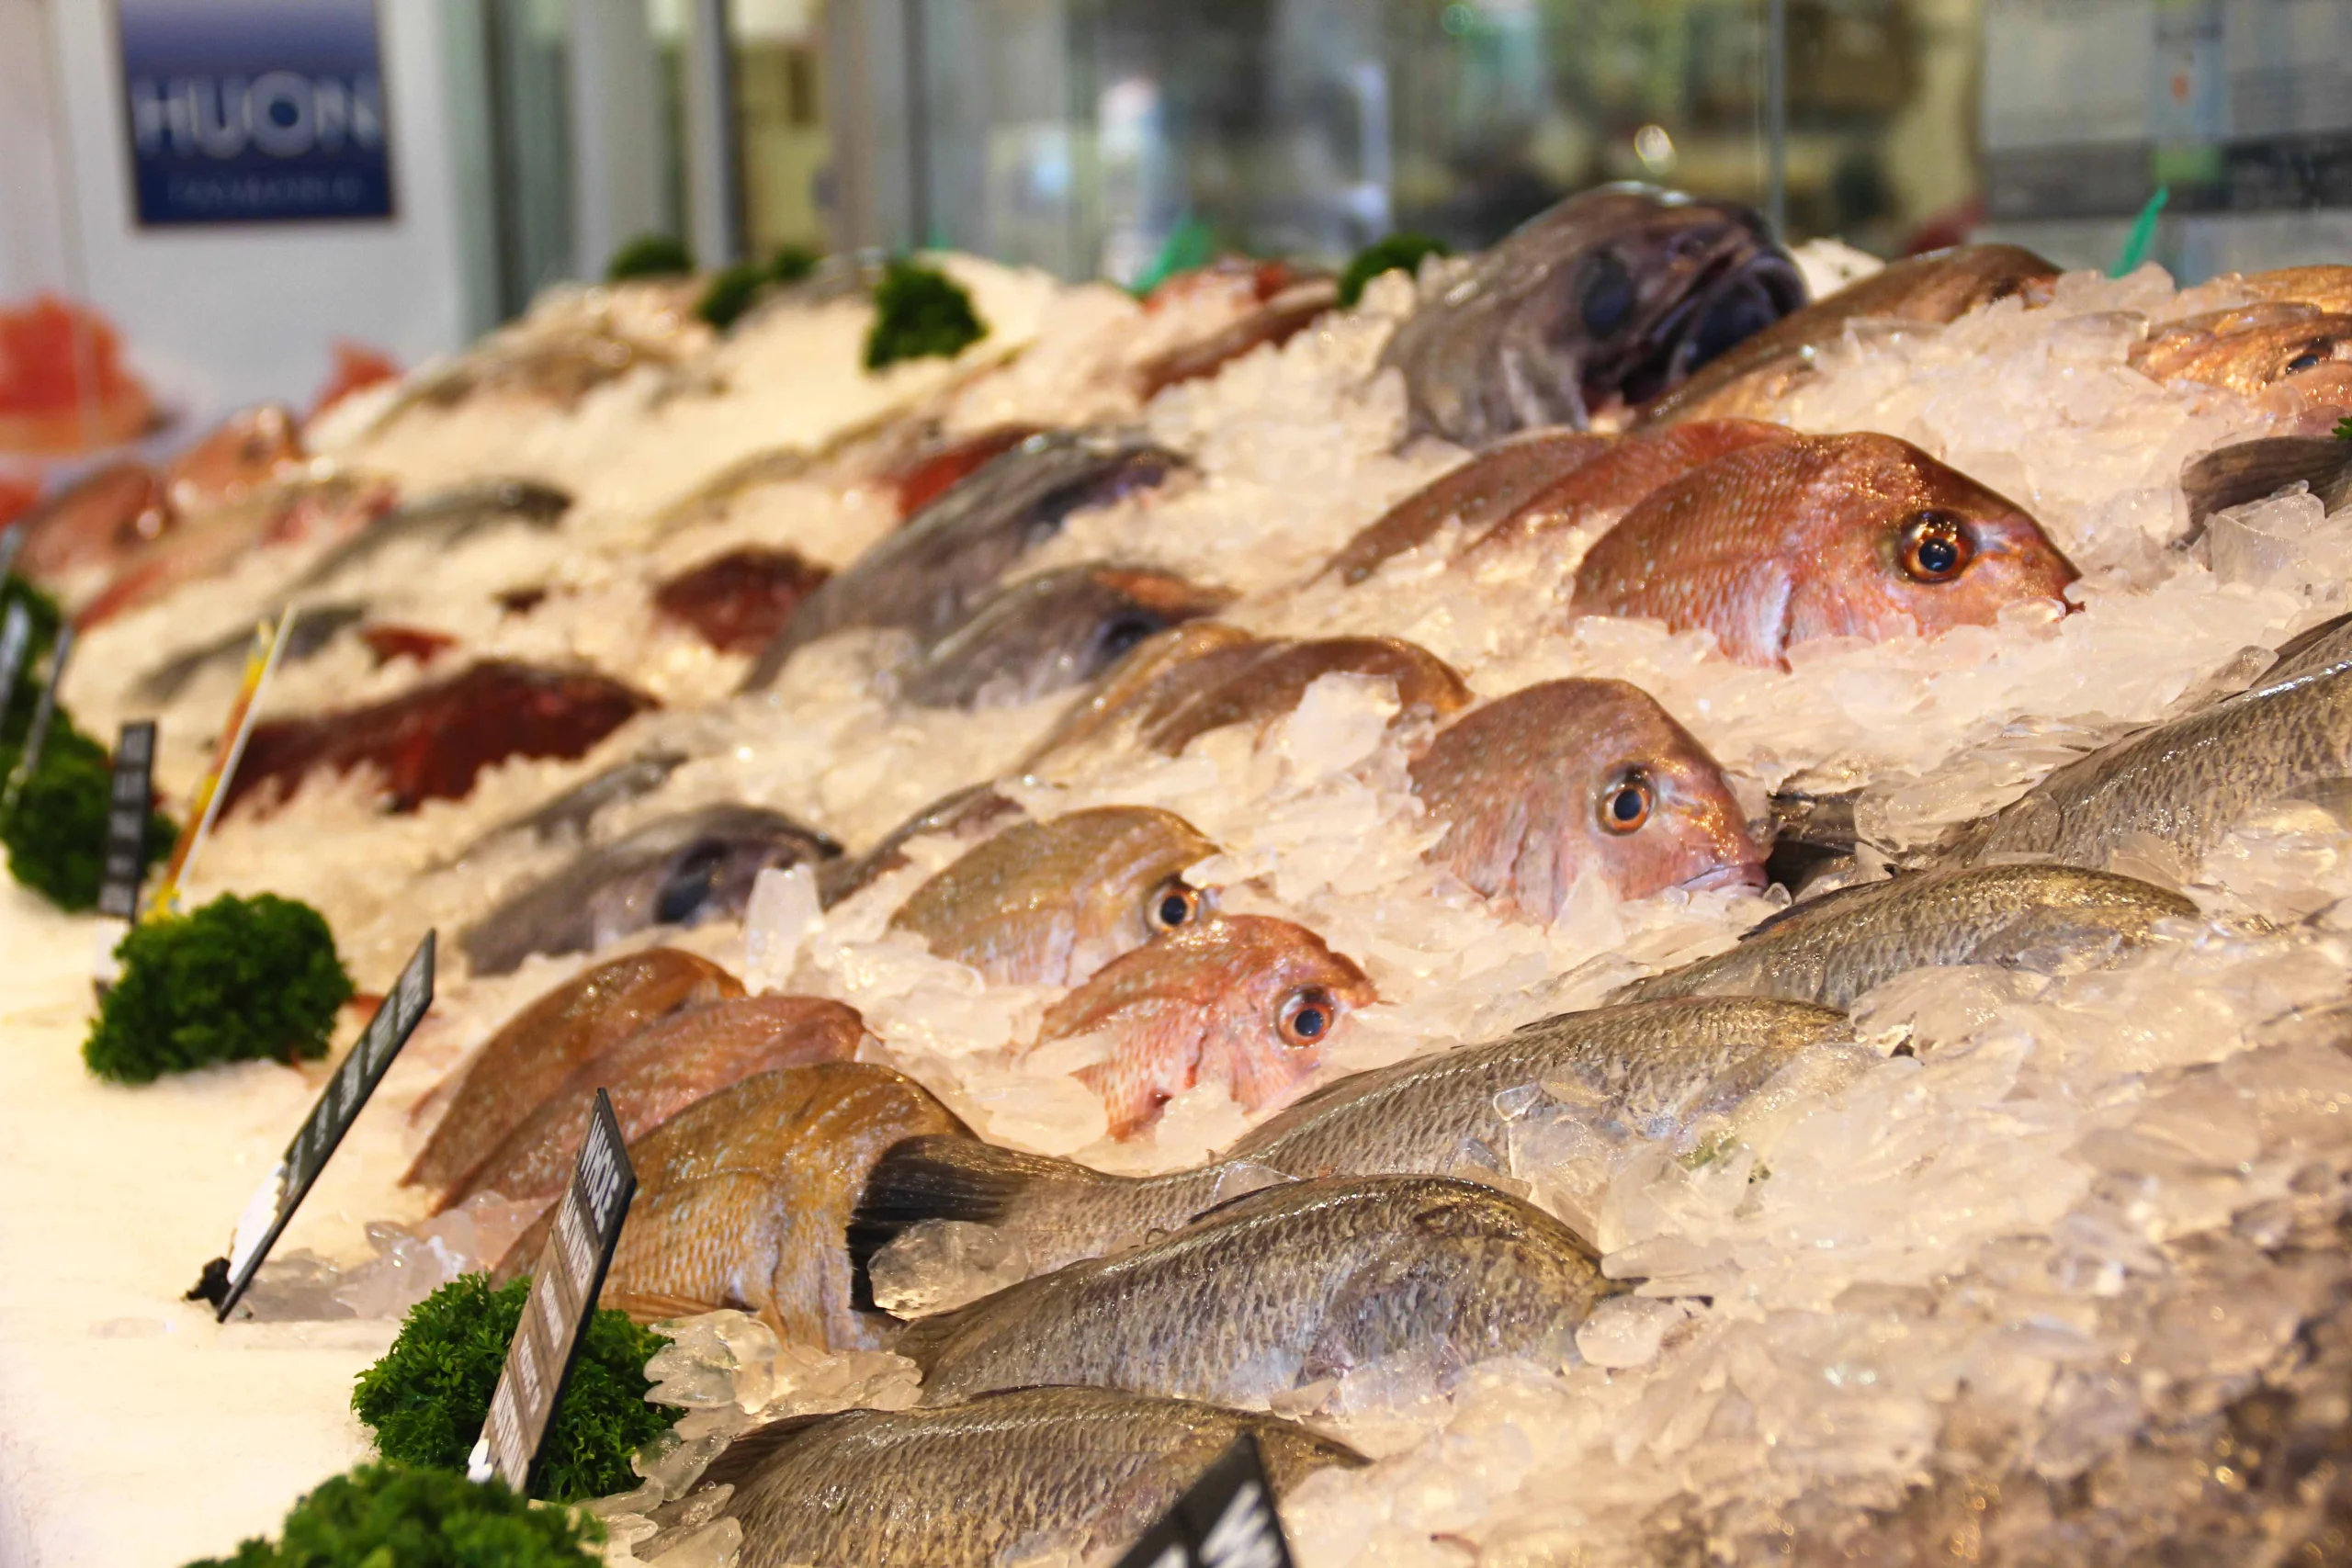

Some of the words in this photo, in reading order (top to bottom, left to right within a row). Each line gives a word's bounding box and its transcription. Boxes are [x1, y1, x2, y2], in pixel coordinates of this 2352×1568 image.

[132, 71, 382, 159] HUON
[580, 1111, 620, 1234] WHOLE
[559, 1187, 594, 1301] SALTWATER
